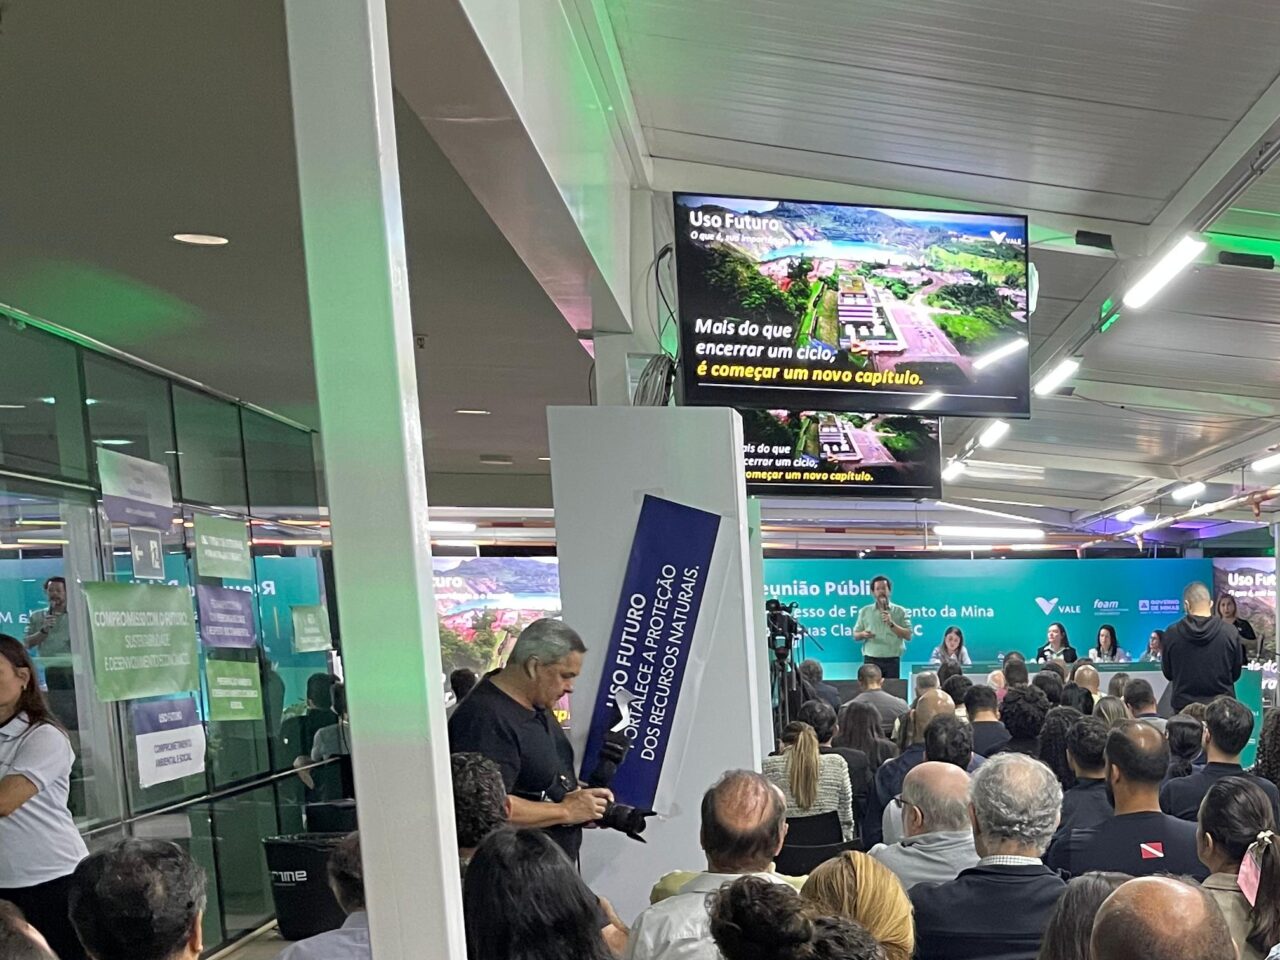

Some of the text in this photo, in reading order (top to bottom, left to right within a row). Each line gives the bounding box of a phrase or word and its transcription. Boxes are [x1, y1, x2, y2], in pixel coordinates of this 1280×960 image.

[689, 211, 779, 231] Uso Futuro
[699, 232, 715, 242] que
[695, 318, 792, 340] Mais do que
[696, 341, 836, 363] encerrar um ciclo,
[697, 360, 924, 386] é começar um novo capítulo.
[743, 444, 791, 456] ais do que
[744, 458, 818, 469] cerrar um ciclo,
[746, 470, 874, 482] omeçar um novo capítulo.
[764, 579, 871, 596] eunião Públi
[1228, 573, 1253, 586] Uso
[793, 606, 826, 617] esso
[829, 605, 846, 617] de
[940, 605, 957, 617] da
[961, 605, 994, 617] Mina
[1058, 605, 1081, 614] VALE
[617, 593, 647, 667] FUTURO
[624, 564, 676, 749] ORTALECE A PROTEÇÃO
[641, 565, 700, 761] DOS RECURSOS NATURAIS.
